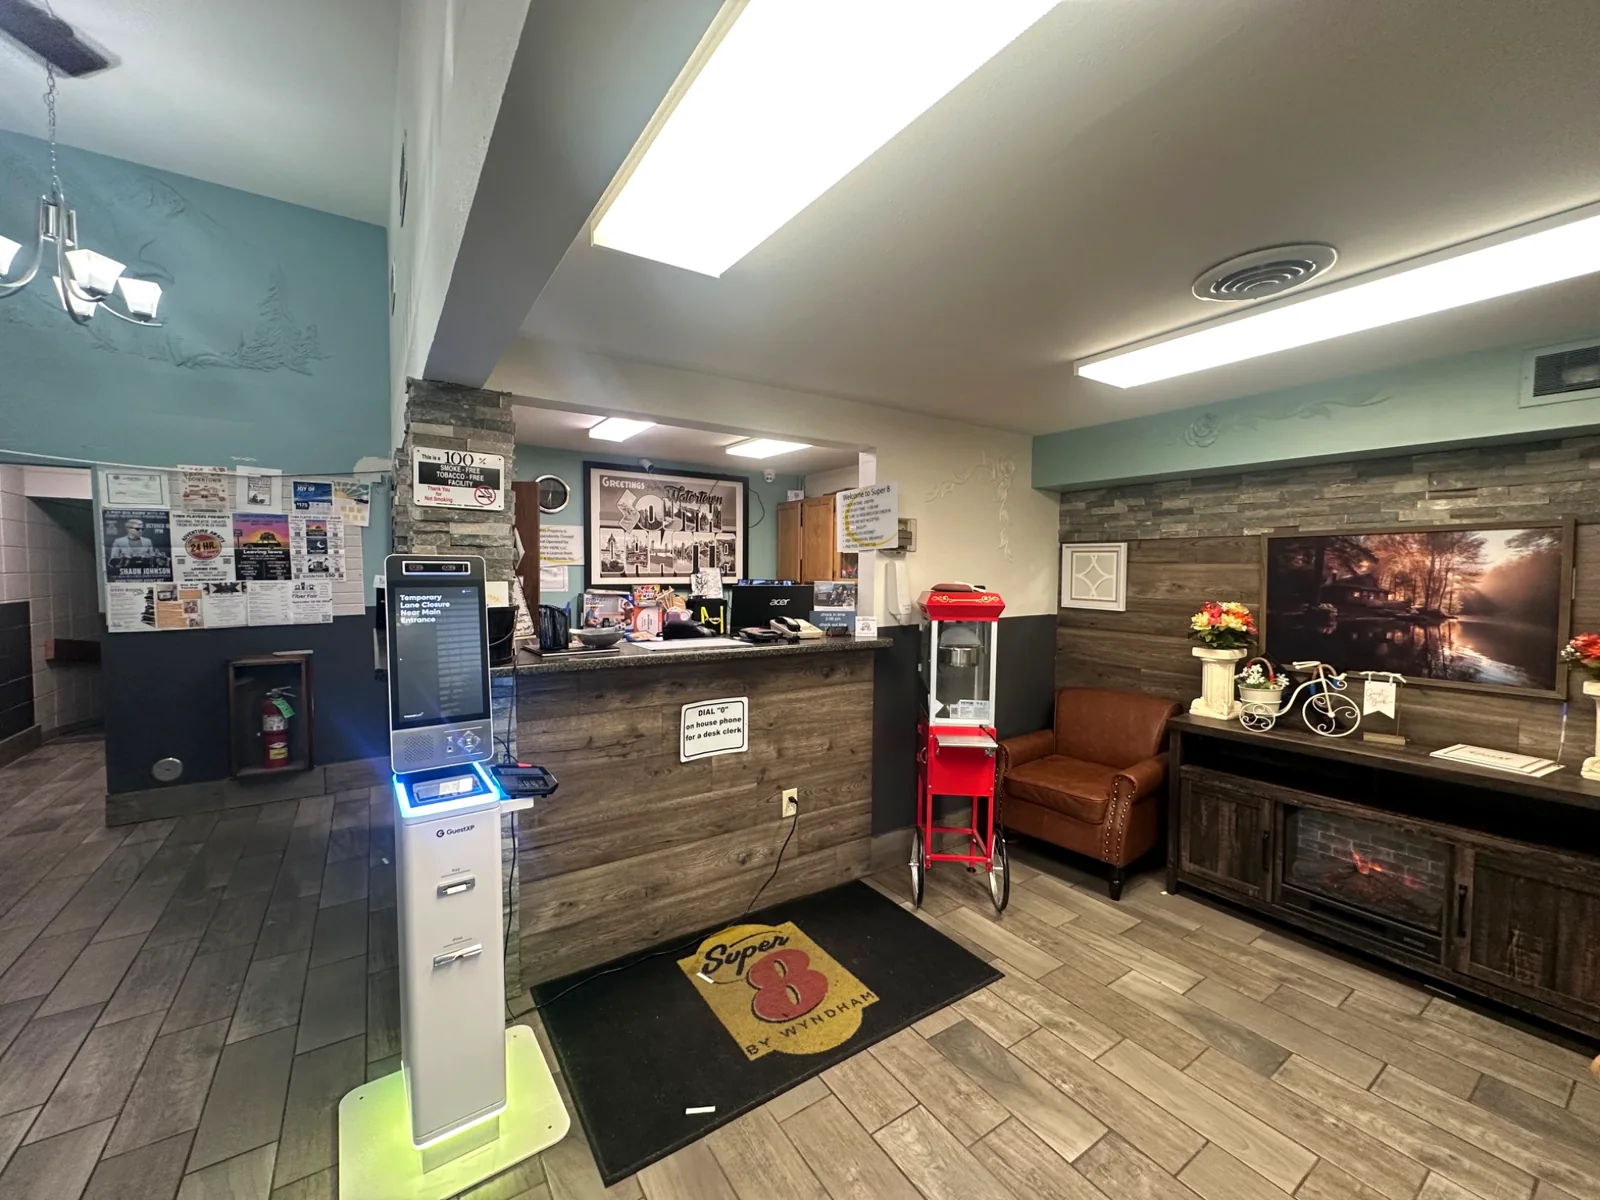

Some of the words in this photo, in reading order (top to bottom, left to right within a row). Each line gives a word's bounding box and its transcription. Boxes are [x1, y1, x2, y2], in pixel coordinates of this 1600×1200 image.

[444, 451, 474, 467] 100
[436, 471, 465, 479] TOBACCO
[664, 485, 722, 505] Watertown
[843, 492, 864, 500] Welcome
[871, 488, 885, 496] Super
[617, 489, 722, 534] SOUTH
[181, 529, 208, 542] ADVENTURE
[190, 544, 201, 552] 24
[203, 542, 217, 550] HR.
[600, 528, 736, 574] DAKOTA
[1366, 688, 1385, 697] Guest
[696, 720, 717, 728] house
[719, 717, 742, 725] phone
[446, 825, 475, 835] GuestXP
[701, 935, 790, 976] Super
[746, 948, 828, 1024] 8
[746, 1038, 770, 1056] BY
[779, 991, 874, 1038] WYNDHAM
